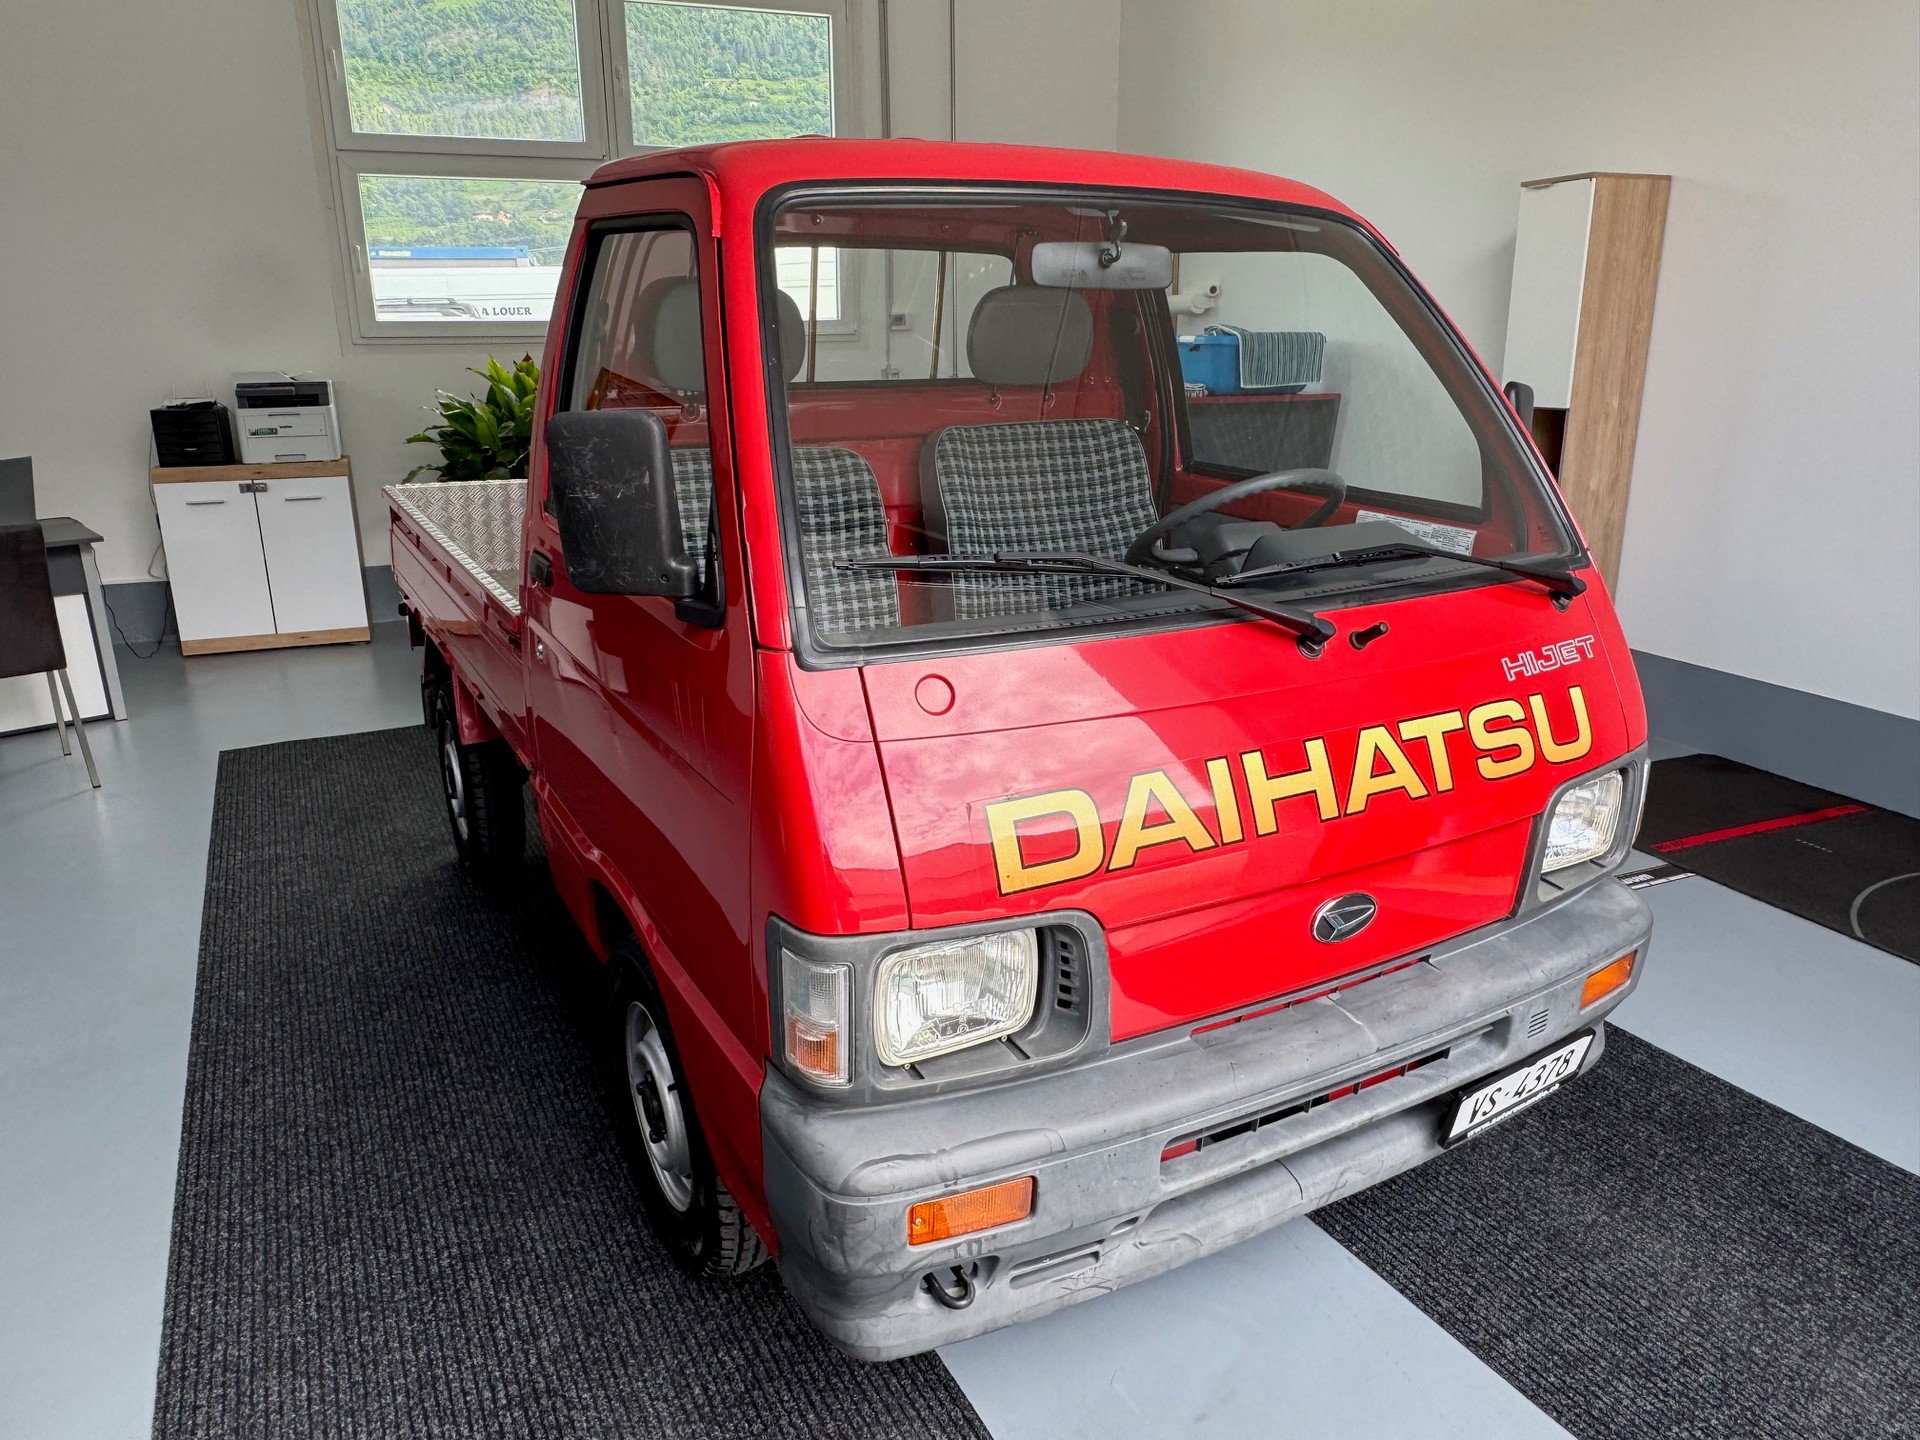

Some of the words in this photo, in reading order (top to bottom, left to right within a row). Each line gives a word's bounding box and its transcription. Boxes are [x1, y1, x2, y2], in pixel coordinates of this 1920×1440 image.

[481, 307, 490, 316] A
[492, 307, 532, 316] LOUER
[1501, 634, 1595, 682] HIJET
[984, 685, 1593, 898] DAIHATSU
